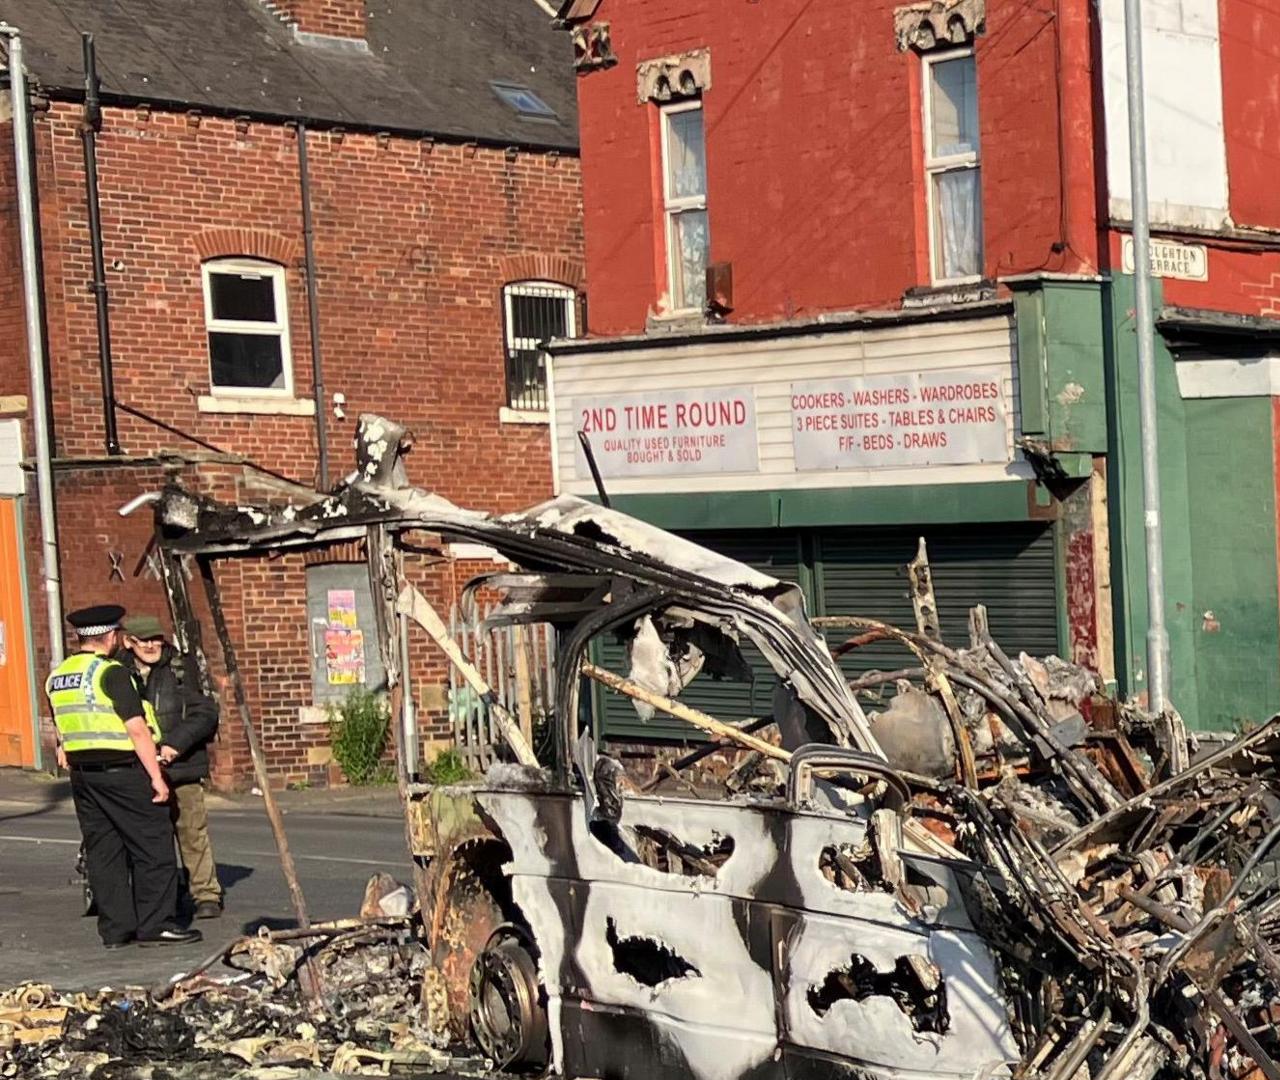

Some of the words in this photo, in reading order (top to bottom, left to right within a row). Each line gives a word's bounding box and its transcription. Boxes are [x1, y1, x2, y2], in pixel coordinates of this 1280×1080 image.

[792, 390, 846, 411] COOKERS
[853, 387, 910, 408] WASHERS
[920, 382, 998, 404] WARDROBES
[581, 408, 617, 433] 2ND
[624, 405, 669, 430] TIME
[676, 400, 747, 427] ROUND
[797, 416, 803, 431] 3
[806, 415, 838, 431] PIECE
[840, 412, 879, 430] SUITES
[889, 408, 935, 427] TABLES
[937, 408, 946, 424] &
[948, 405, 996, 424] CHAIRS
[603, 436, 641, 452] QUALITY
[644, 435, 669, 450] USED
[672, 433, 726, 449] FURNITURE
[838, 434, 855, 452] F/F
[863, 432, 894, 450] BEDS
[903, 431, 948, 449] DRAWS
[626, 449, 665, 464] BOUGHT
[667, 450, 675, 463] &
[677, 448, 702, 462] SOLD
